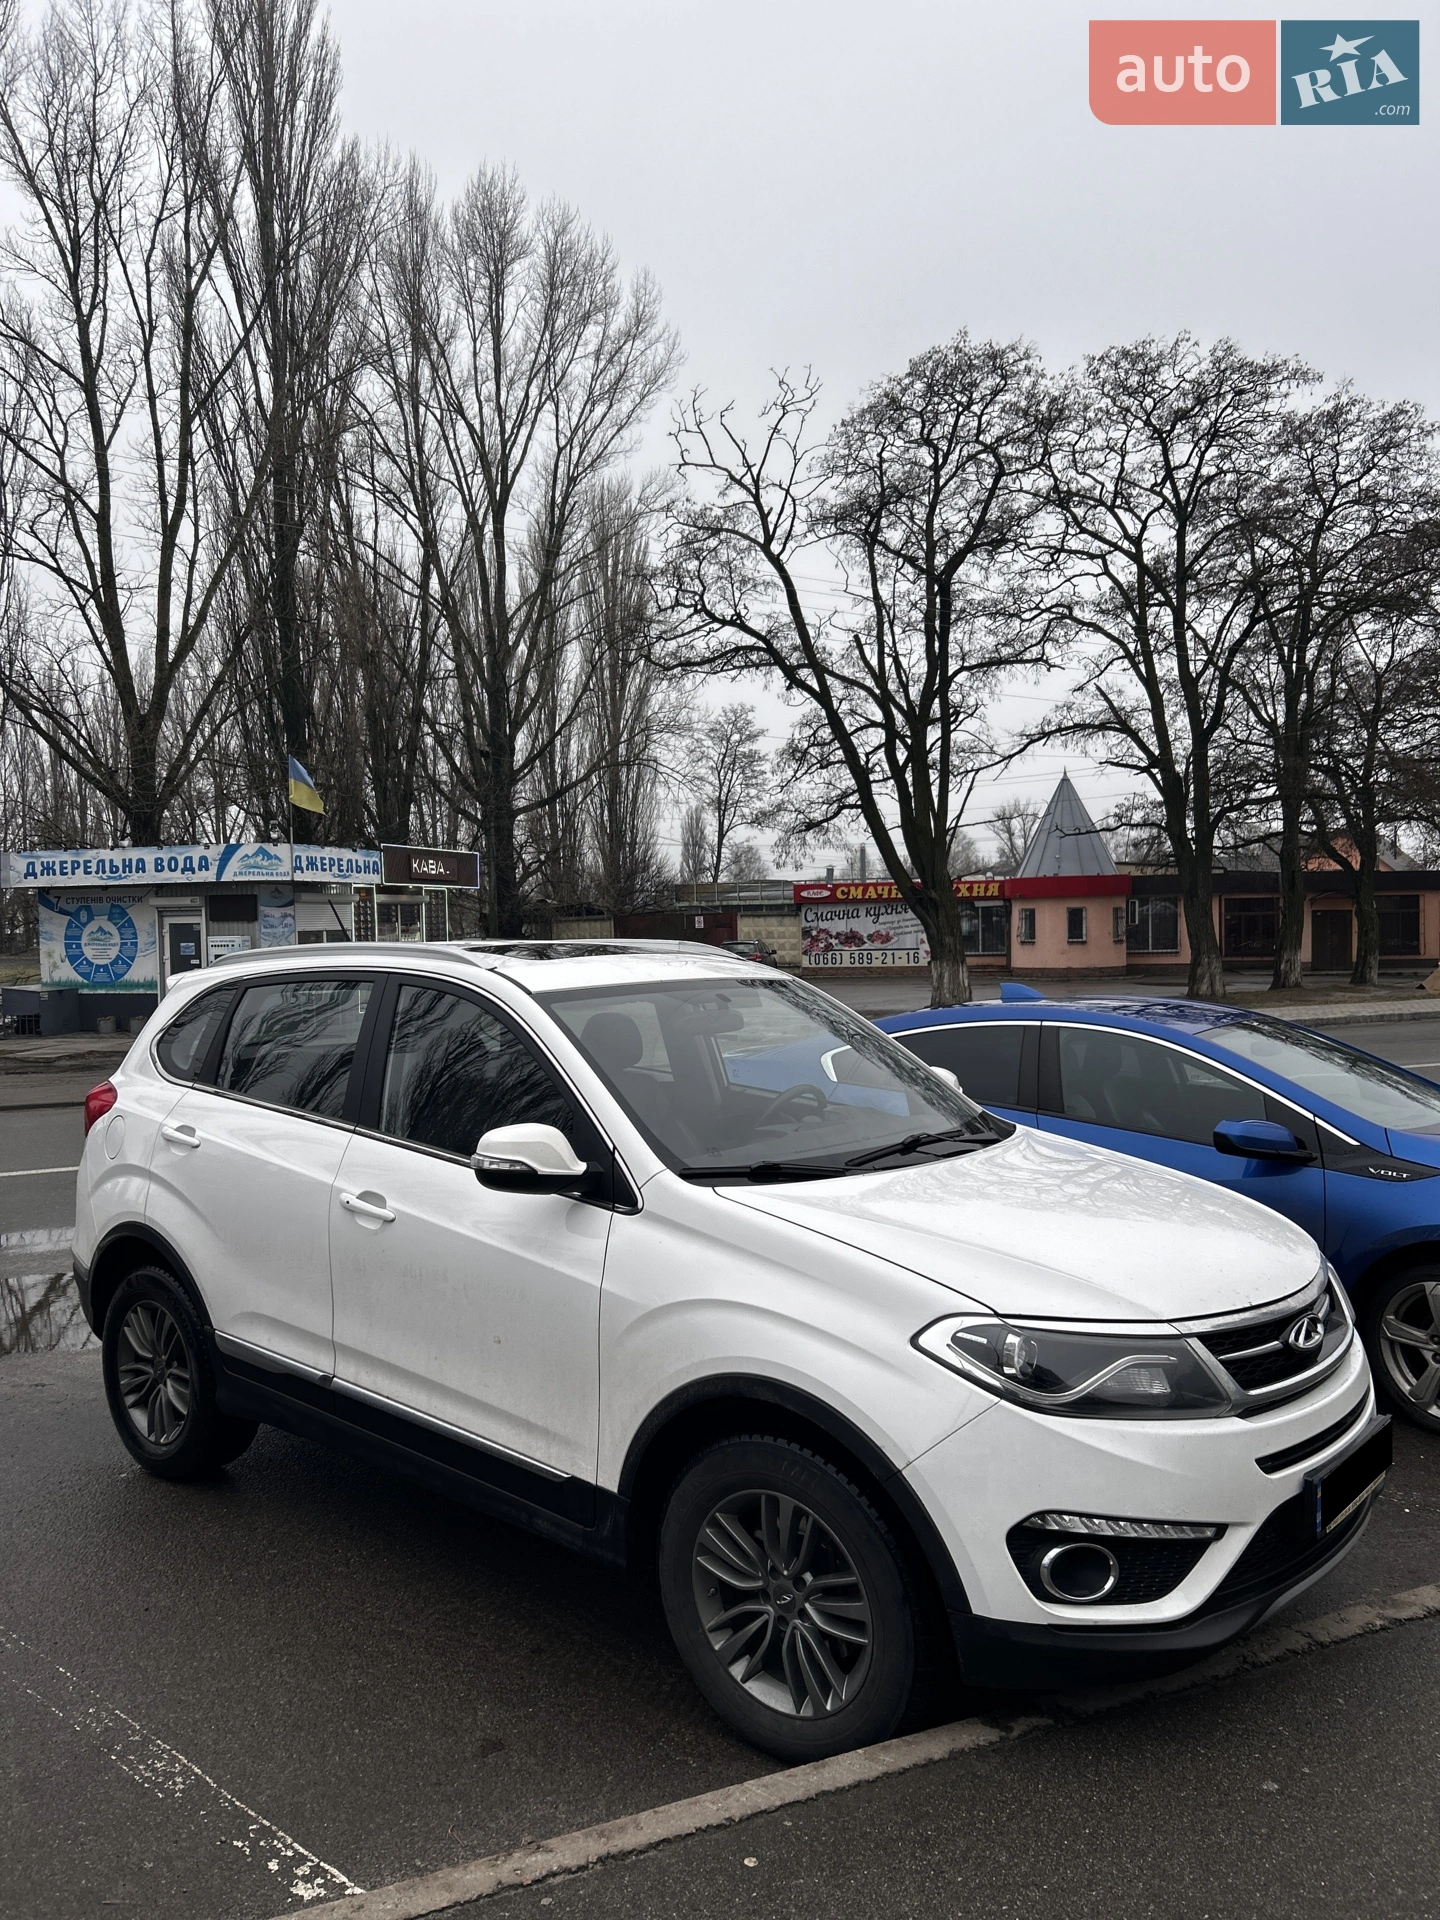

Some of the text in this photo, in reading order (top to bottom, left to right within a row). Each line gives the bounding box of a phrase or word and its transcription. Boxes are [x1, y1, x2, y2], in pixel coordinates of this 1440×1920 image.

[24, 855, 211, 880] ДЖЕРЕЛЬНА ВОДА
[293, 854, 380, 876] ДЖЕРЕЛЬНА
[835, 882, 1000, 900] СМАЧН ХНЯ
[53, 894, 144, 912] 7 СТУПЕНІВ ОЧИСТКИ
[803, 907, 861, 924] Смачна
[865, 903, 910, 924] кухня
[808, 952, 920, 966] (066) 589-21-16
[1368, 1167, 1410, 1178] VOLT
